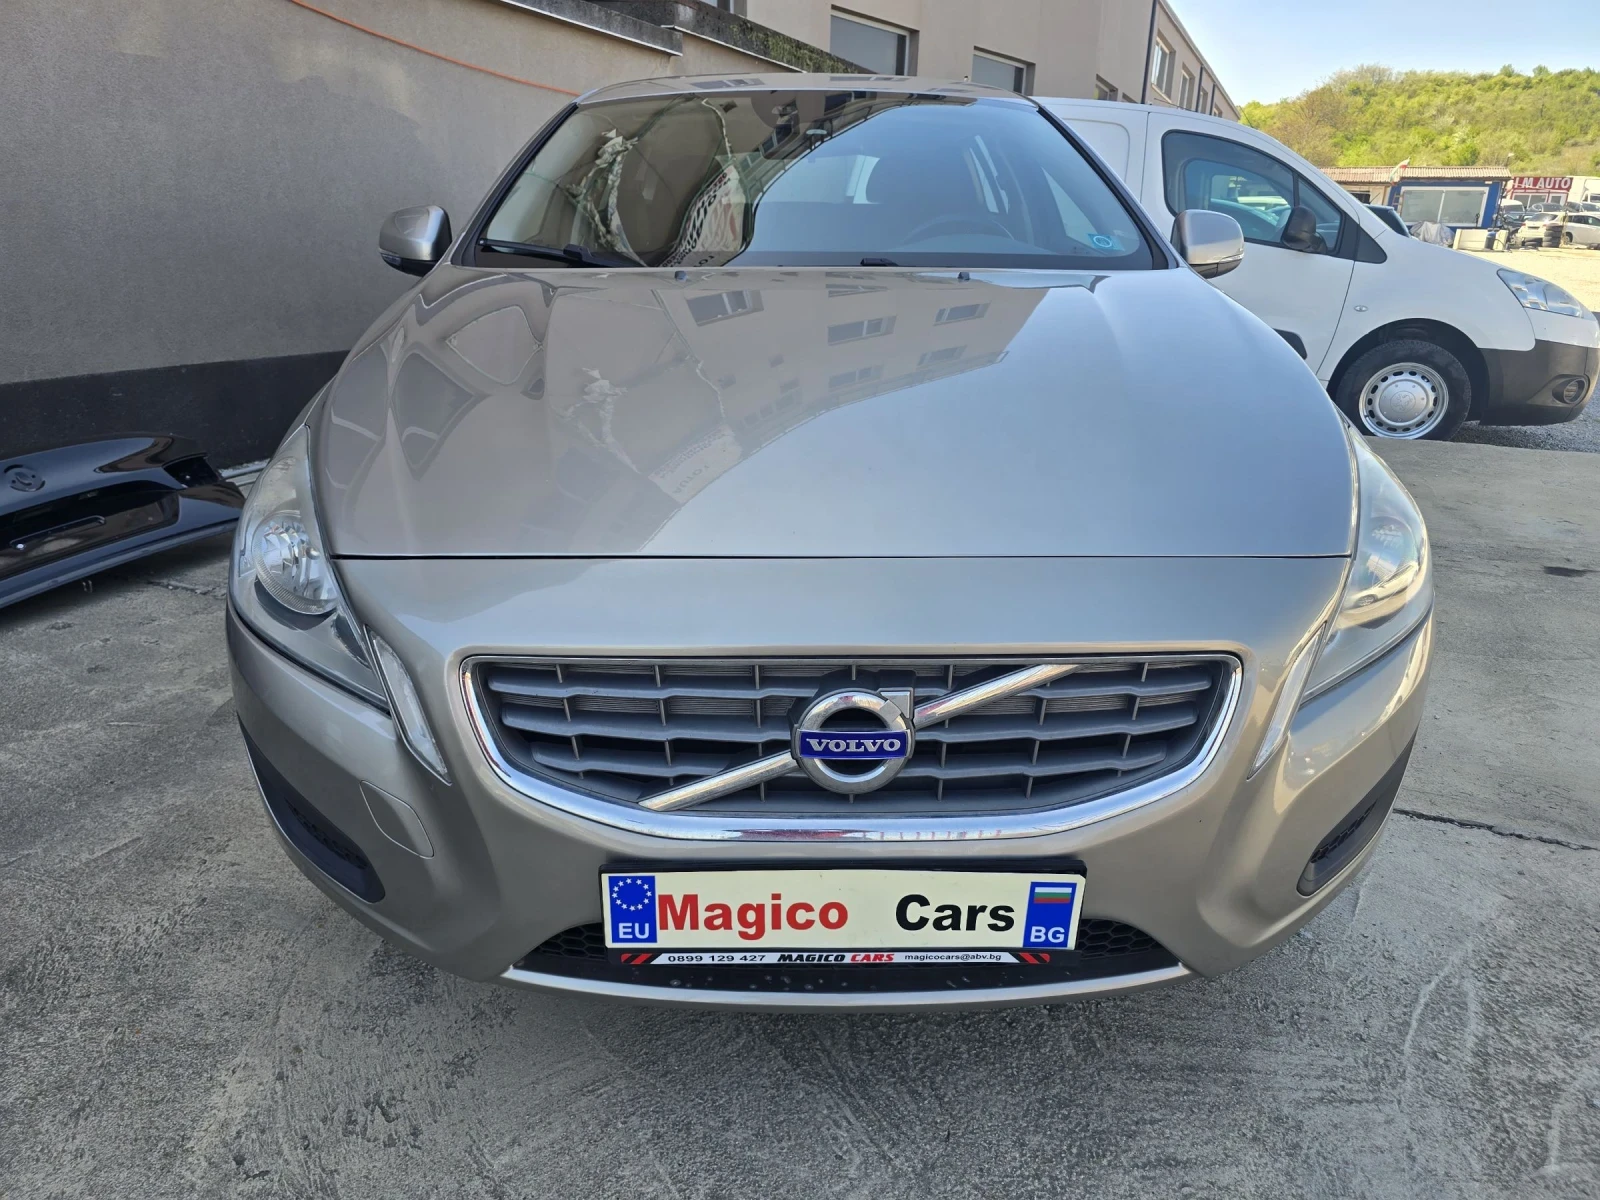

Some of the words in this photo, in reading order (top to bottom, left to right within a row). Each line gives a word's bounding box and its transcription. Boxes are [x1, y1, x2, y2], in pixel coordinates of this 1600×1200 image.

[1536, 177, 1571, 189] AUTO
[806, 738, 901, 752] VOLVO
[658, 893, 848, 940] Magico
[895, 894, 1015, 932] Cars
[618, 922, 650, 939] EU
[1030, 926, 1066, 943] BG
[739, 954, 766, 962] 427
[777, 953, 846, 962] MAGICO
[850, 953, 895, 962] CARS
[904, 953, 1002, 962] magicocars@abv.bg
